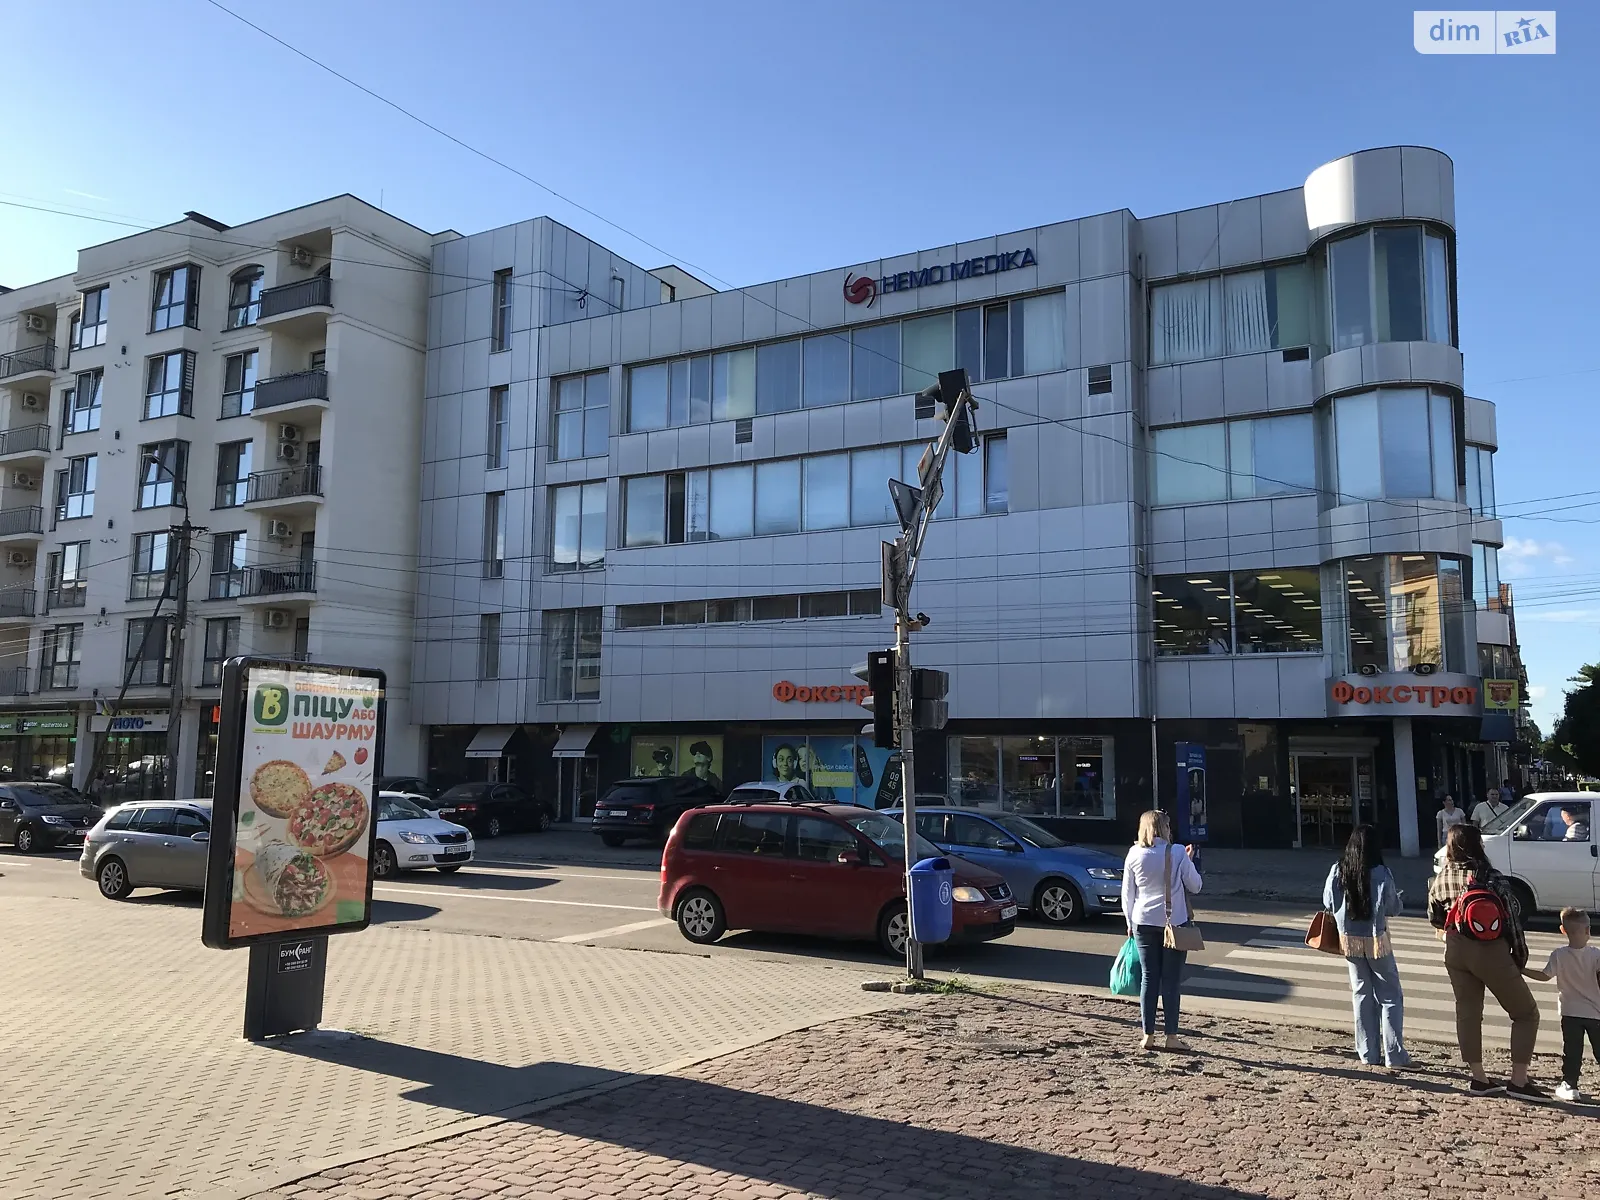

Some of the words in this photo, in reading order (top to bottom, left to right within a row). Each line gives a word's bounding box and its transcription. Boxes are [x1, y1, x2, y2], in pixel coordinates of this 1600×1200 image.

[882, 265, 943, 293] HEMO
[950, 247, 1038, 281] MEDIKA
[772, 680, 874, 706] Фокстр
[1331, 681, 1478, 708] Фокстрот
[293, 694, 354, 722] ПІЦУ
[351, 708, 376, 720] АБО
[114, 716, 144, 730] MOYO
[291, 721, 375, 741] ШАУРМУ
